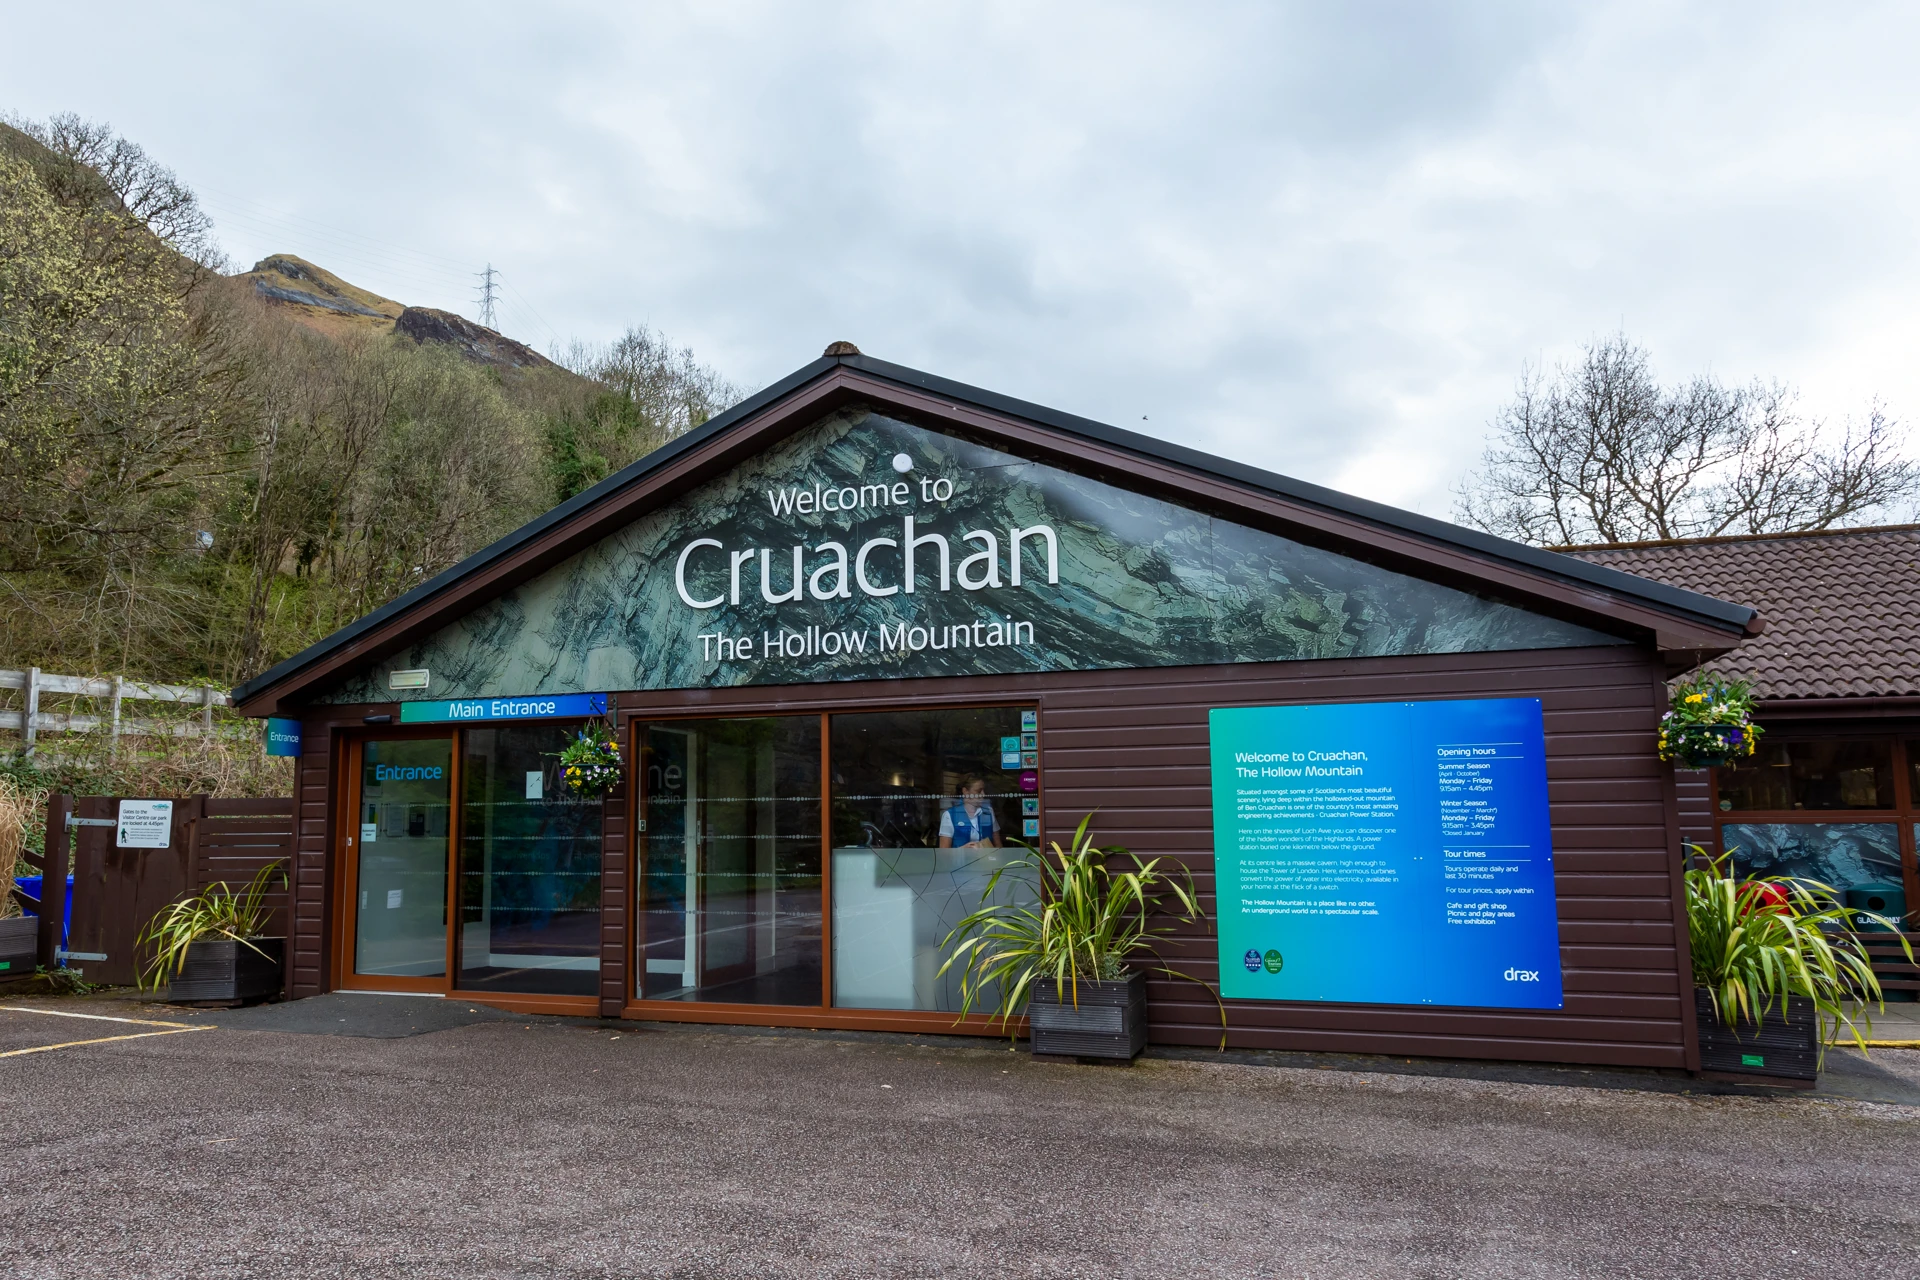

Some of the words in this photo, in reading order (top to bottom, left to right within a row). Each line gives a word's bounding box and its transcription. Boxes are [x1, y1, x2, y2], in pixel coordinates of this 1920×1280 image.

[768, 482, 910, 516] Welcome
[920, 476, 952, 504] to
[676, 516, 1059, 609] Cruachan
[698, 632, 752, 662] The
[764, 626, 868, 658] Hollow
[880, 615, 1034, 652] Mountain
[448, 702, 484, 718] Main
[492, 701, 556, 716] Entrance
[271, 732, 299, 742] Entrance
[1236, 752, 1289, 763] Welcome
[1292, 752, 1305, 762] to
[1308, 750, 1368, 762] Cruachan,
[1437, 748, 1471, 756] Opening
[376, 764, 442, 780] Entrance
[1236, 767, 1258, 778] The
[1262, 767, 1302, 777] Hollow
[1305, 765, 1363, 776] Mountain
[1504, 967, 1539, 982] drax
